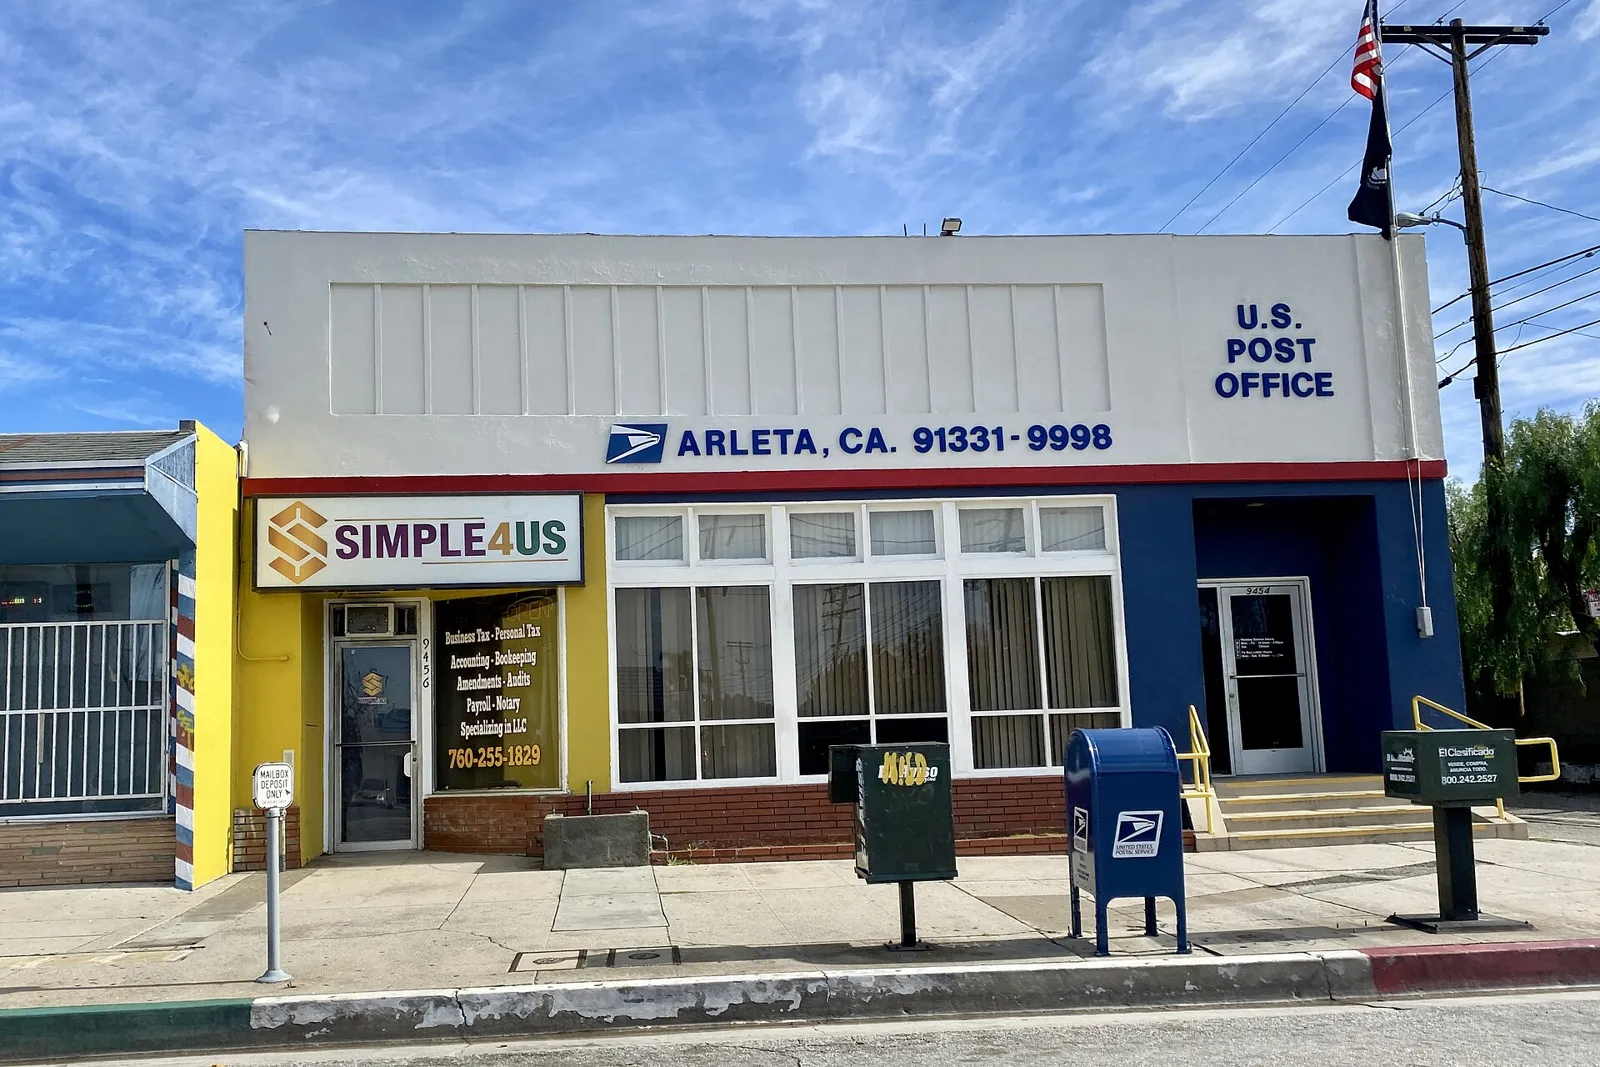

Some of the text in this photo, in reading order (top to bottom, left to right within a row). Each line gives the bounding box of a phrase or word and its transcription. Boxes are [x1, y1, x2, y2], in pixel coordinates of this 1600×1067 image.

[1237, 303, 1302, 329] U.S.
[1227, 337, 1316, 363] POST
[1215, 372, 1334, 398] OFFICE
[677, 428, 829, 458] ARLETA,
[839, 427, 897, 454] CA.
[335, 519, 567, 560] SIMPLE4US
[1246, 587, 1270, 595] 9454
[445, 629, 475, 645] Business
[476, 628, 490, 643] Tax
[495, 623, 525, 641] Personal
[526, 623, 541, 637] Tax
[422, 638, 430, 688] 9456
[450, 651, 490, 670] Accounting
[494, 647, 537, 667] Bookeeping
[457, 673, 502, 691] Amendments
[507, 670, 531, 688] Audits
[466, 695, 491, 716] Payroll
[496, 695, 521, 713] Notary
[460, 718, 527, 740] Specializing in LLC
[448, 744, 541, 769] 760-255-1829
[260, 769, 289, 779] MAILBOX
[261, 780, 288, 789] DEPOSIT
[1441, 774, 1498, 785] 800.242.2527
[266, 790, 283, 799] ONLY
